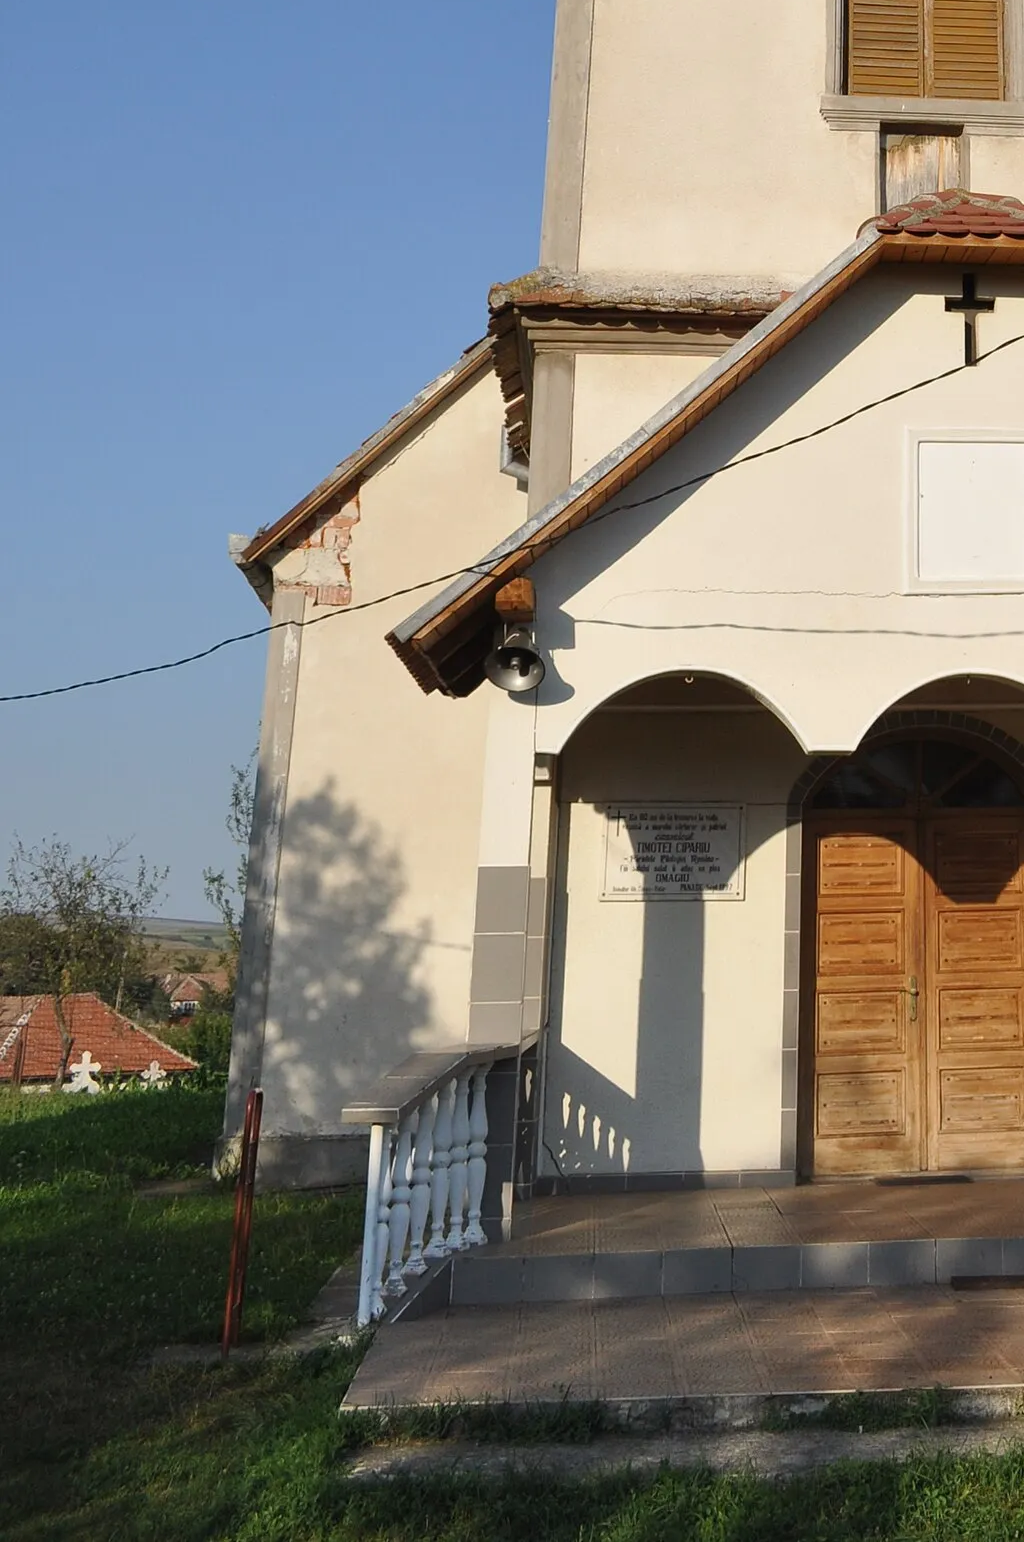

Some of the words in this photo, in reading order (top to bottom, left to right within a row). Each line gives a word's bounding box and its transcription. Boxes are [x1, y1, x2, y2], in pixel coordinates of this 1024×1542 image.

[637, 841, 672, 853] TIMOTEI
[675, 841, 711, 853] CIPARIU
[655, 873, 690, 883] OMAGIU
